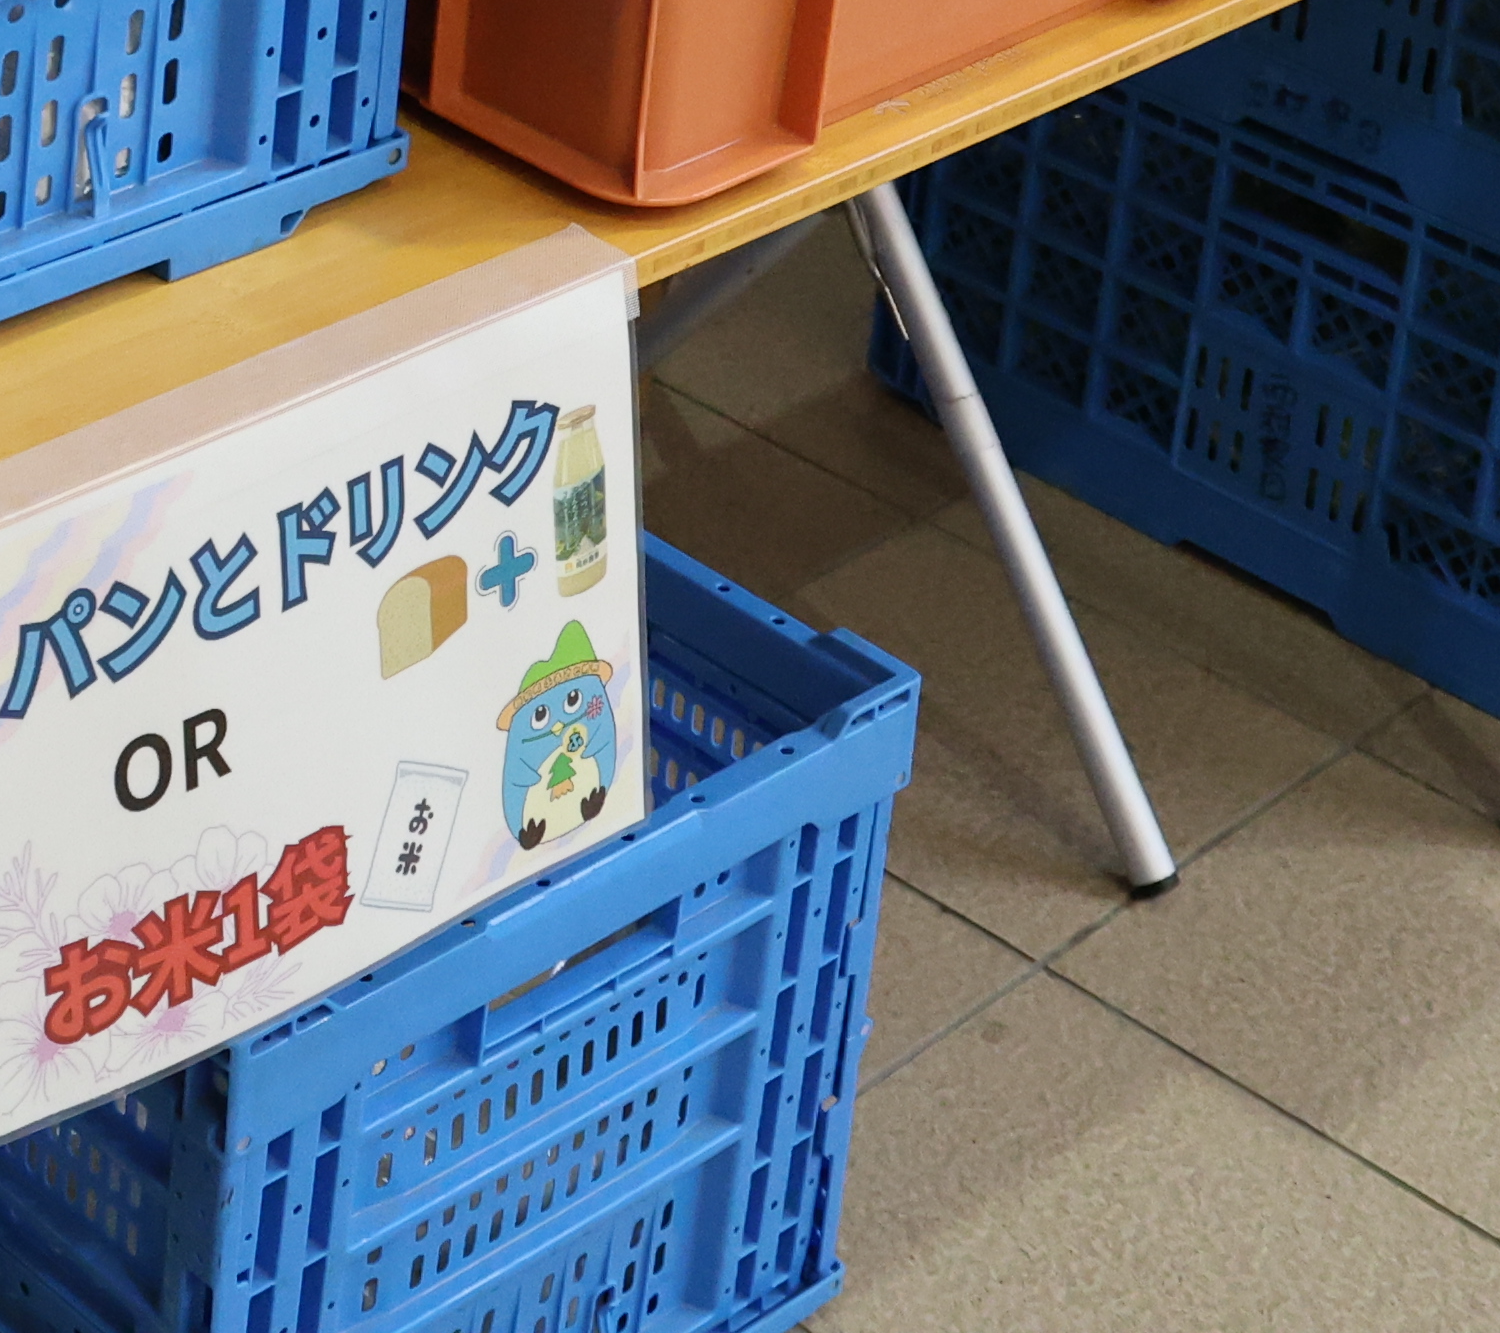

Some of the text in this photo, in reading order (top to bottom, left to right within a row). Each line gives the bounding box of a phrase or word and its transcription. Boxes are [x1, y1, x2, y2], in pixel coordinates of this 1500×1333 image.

[113, 707, 232, 812] OR
[396, 798, 436, 877] お米
[43, 824, 355, 1045] お米1袋
